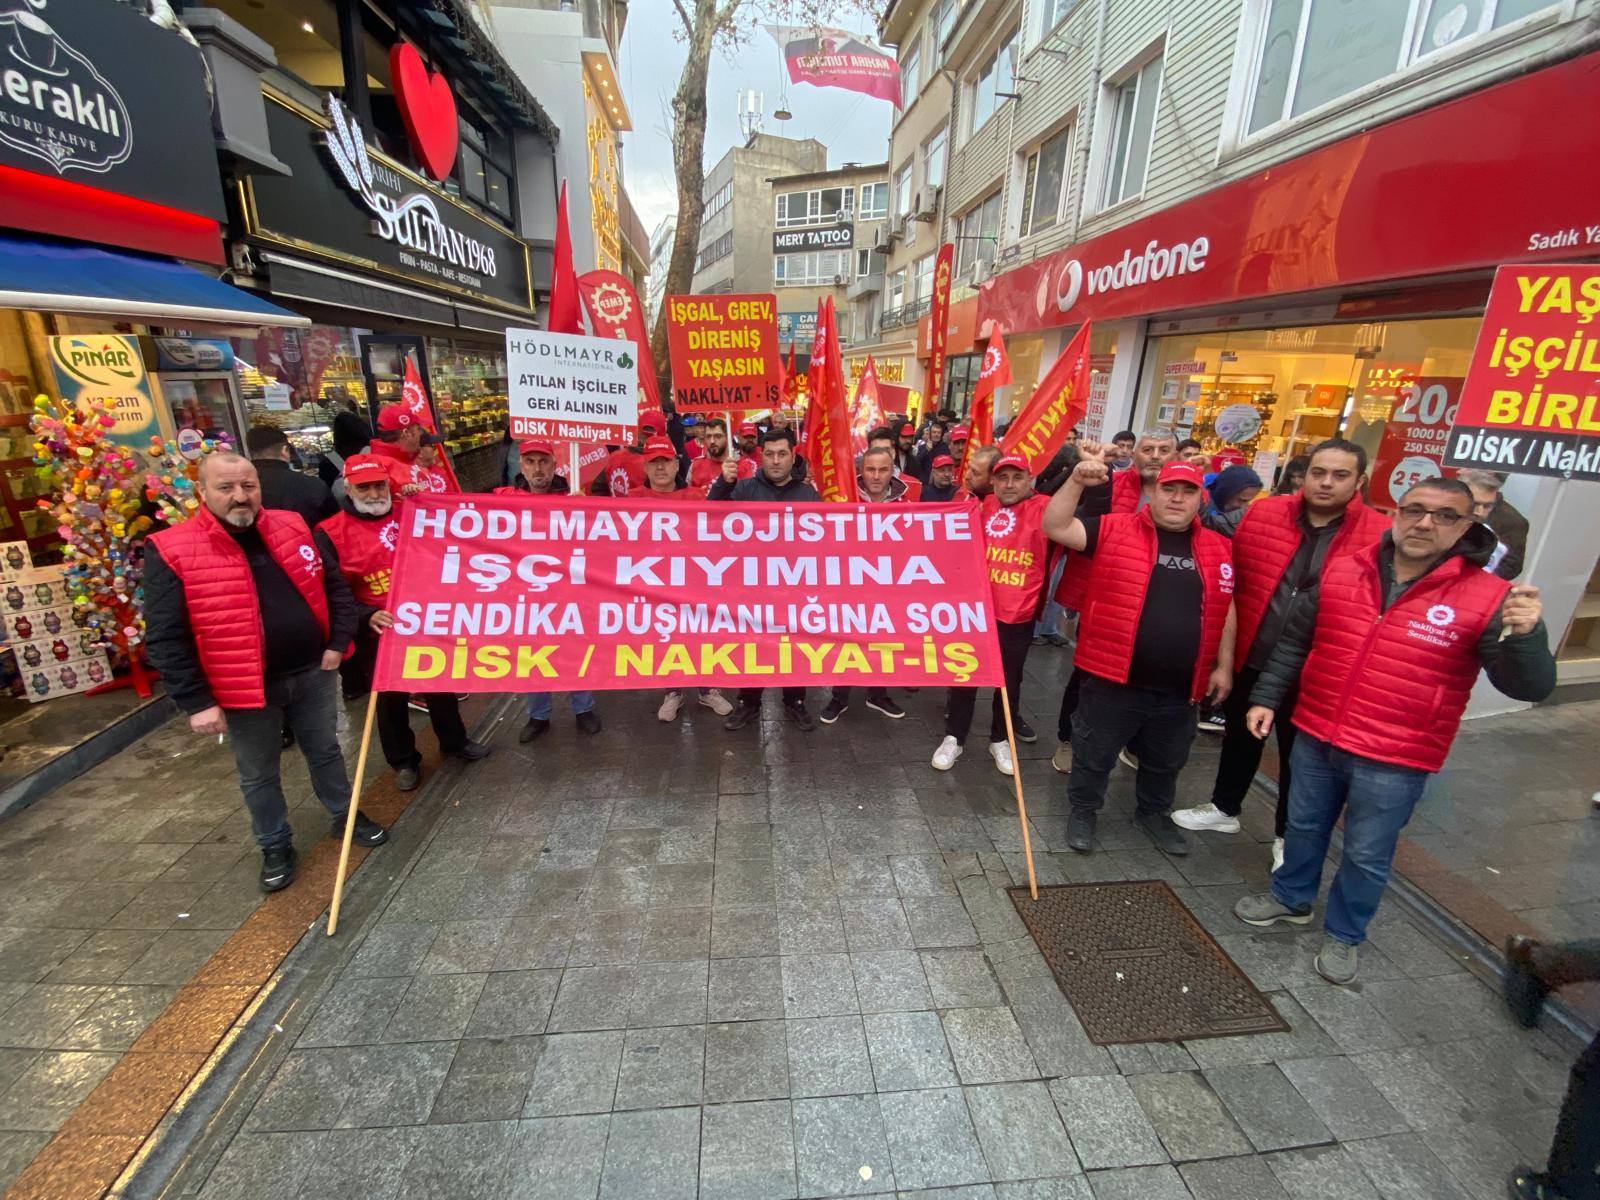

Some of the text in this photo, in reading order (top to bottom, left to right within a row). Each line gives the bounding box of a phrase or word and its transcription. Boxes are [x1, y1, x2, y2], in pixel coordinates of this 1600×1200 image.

[0, 69, 120, 138] eraklı
[0, 110, 97, 152] KURU KAHVE
[371, 163, 402, 193] ARİHİ
[776, 229, 851, 247] MERY TATTOO
[1528, 229, 1579, 251] Sadık
[1087, 236, 1210, 296] vodafone
[670, 298, 774, 326] İŞGAL, GREV,
[510, 339, 614, 363] HÖDLMAYR
[688, 325, 761, 352] DİRENİŞ
[71, 351, 132, 367] PINAR
[554, 360, 614, 372] INTERNATIONAL
[688, 357, 765, 381] YAŞASIN
[519, 373, 566, 390] ATILAN
[572, 376, 627, 395] İŞCİLER
[677, 383, 752, 405] NAKLİYAT
[765, 381, 779, 406] İŞ
[86, 396, 140, 408] yaam
[527, 397, 617, 416] GERİ ALINSIN
[514, 418, 548, 436] DİSK
[558, 423, 611, 442] Nakliyat
[622, 425, 634, 445] İş
[1406, 427, 1434, 439] 1000
[1403, 441, 1422, 453] 250
[1453, 428, 1600, 474] DİSK / Nakl
[412, 502, 682, 542] HÖDLMAYR
[440, 545, 946, 592] İŞÇİ KIYIMINA
[393, 594, 988, 643] SENDİKA DÜŞMANLIĞINA SON
[402, 635, 980, 683] DİSK / NAKLİYAT-İŞ
